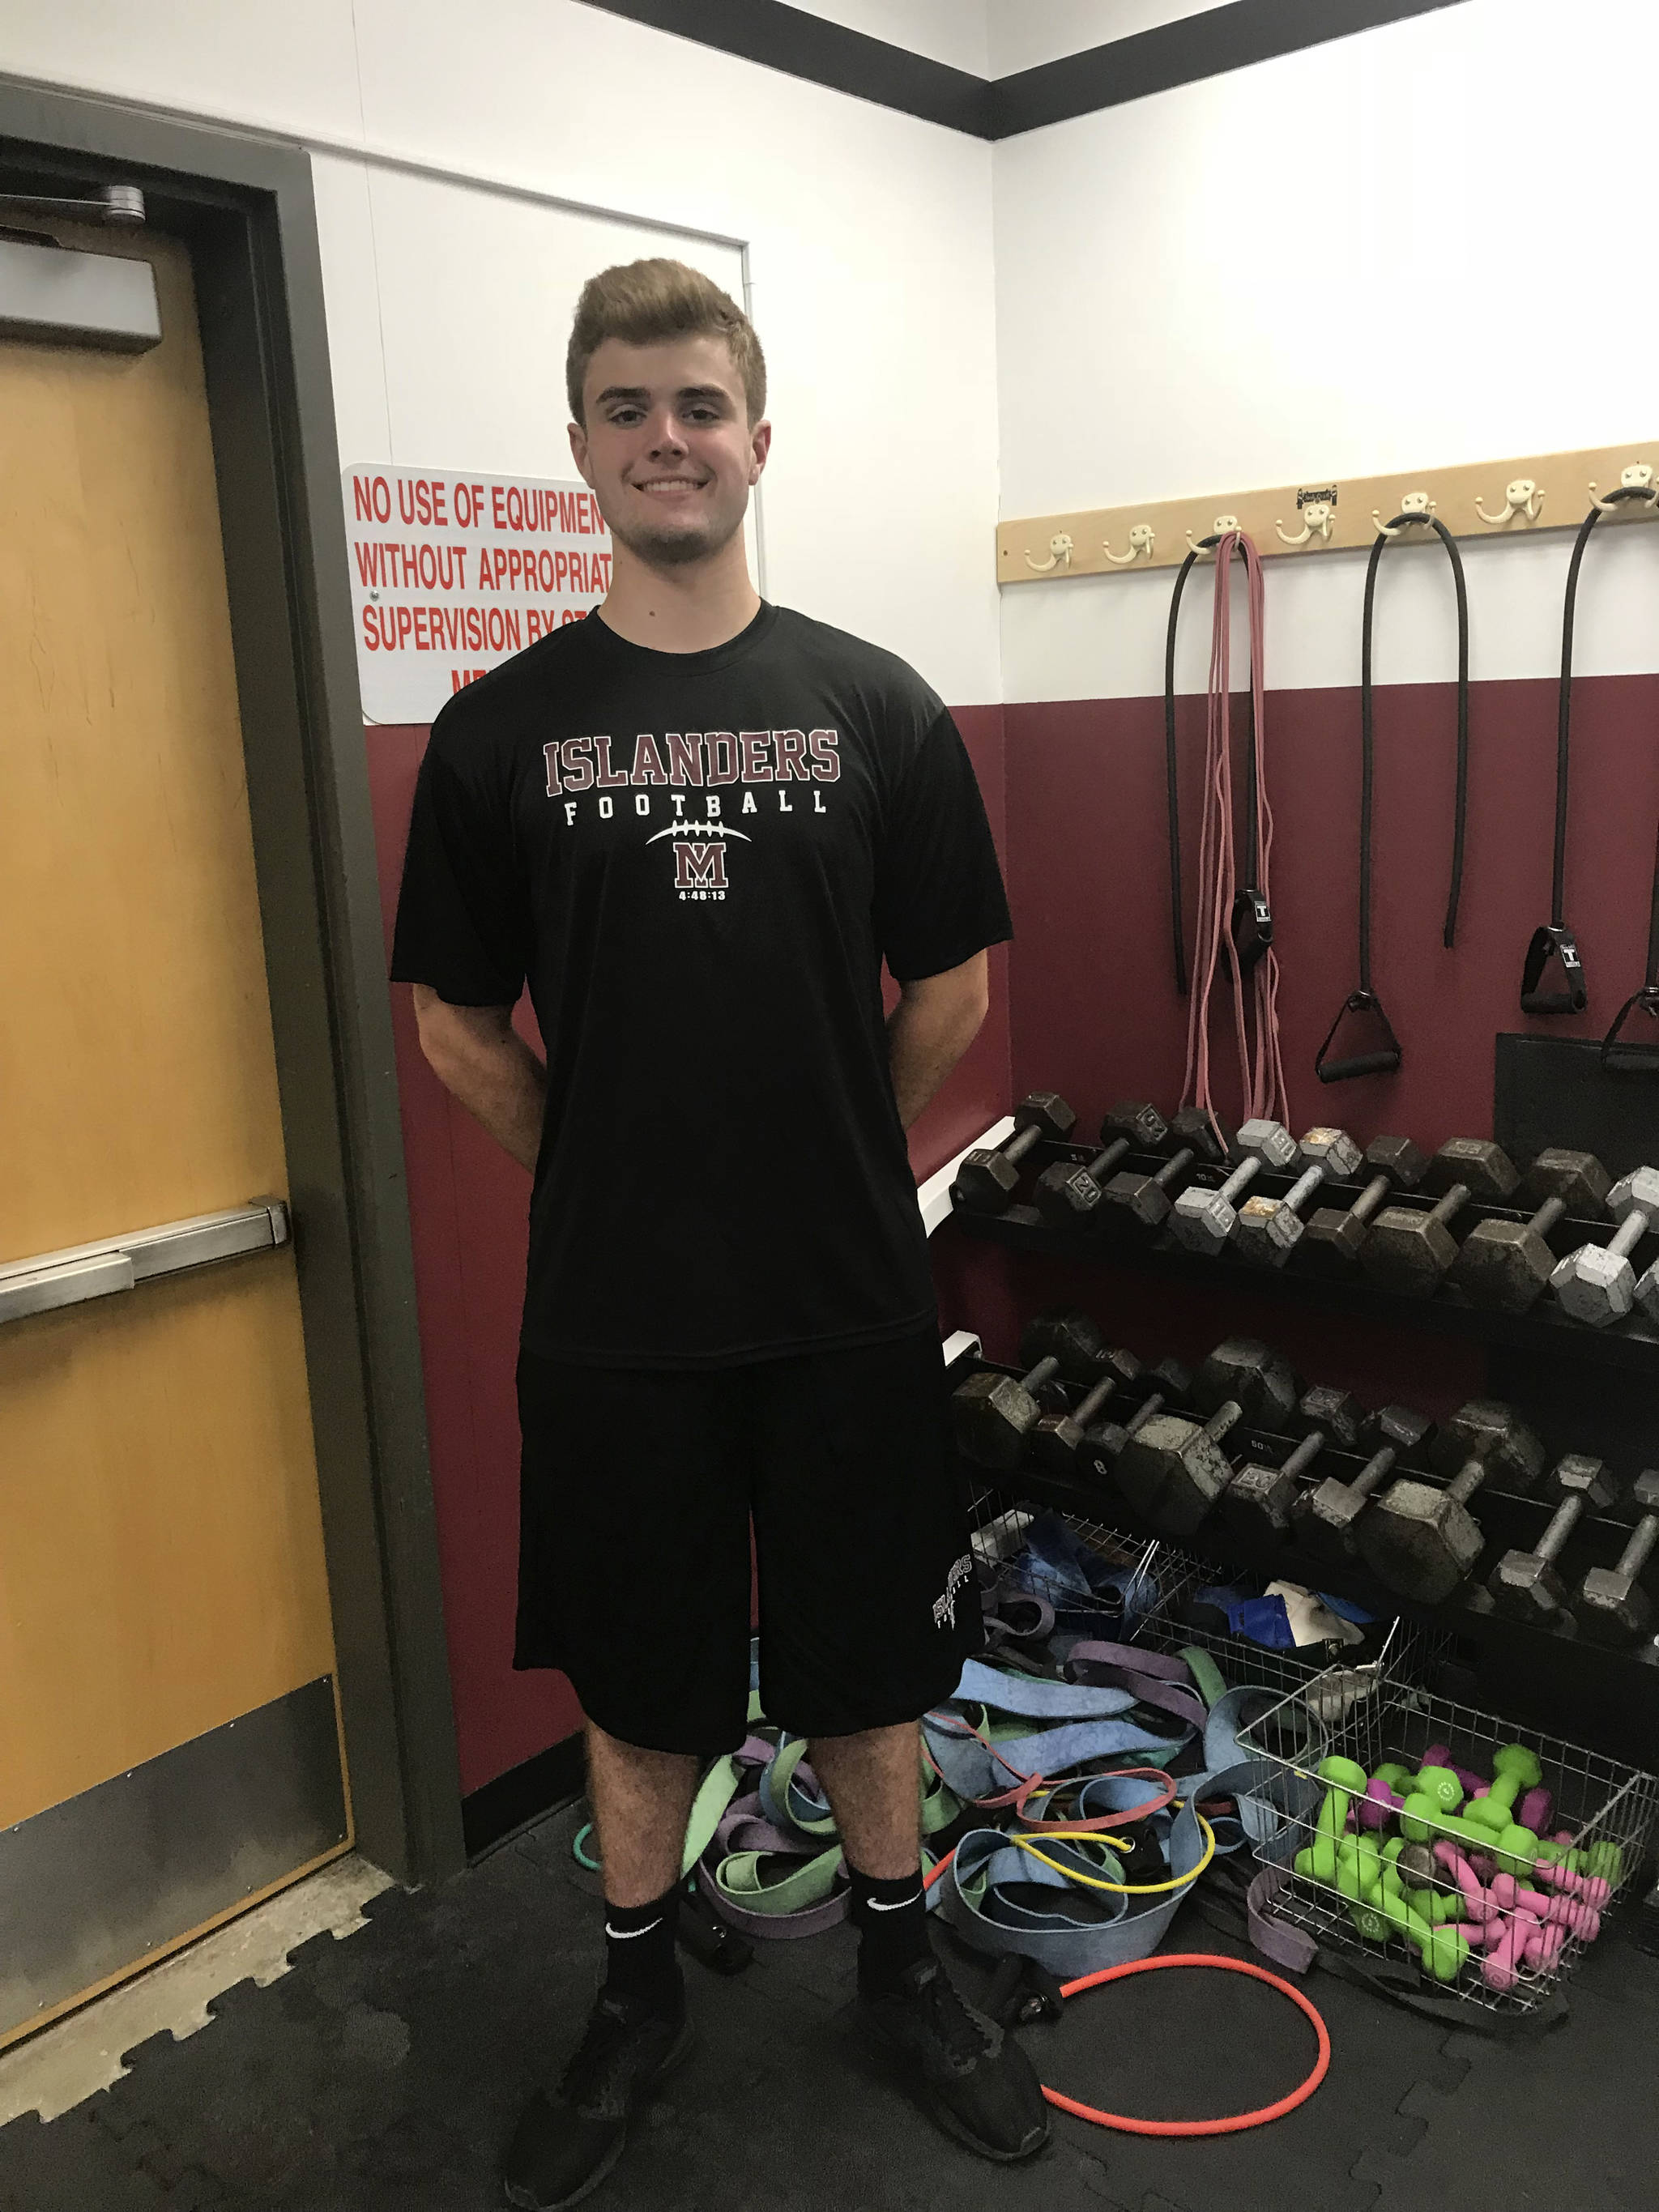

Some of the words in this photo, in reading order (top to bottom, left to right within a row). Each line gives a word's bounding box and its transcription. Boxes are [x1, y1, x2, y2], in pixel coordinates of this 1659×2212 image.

[353, 475, 391, 523] NO
[398, 479, 448, 526] USE
[454, 483, 484, 528] OF
[354, 542, 467, 590] WITHOUT
[363, 604, 522, 651] SUPERVISION
[544, 729, 841, 797] ISLANDERS
[564, 790, 826, 826] FOOTBALL
[679, 890, 726, 901] 4:48:13
